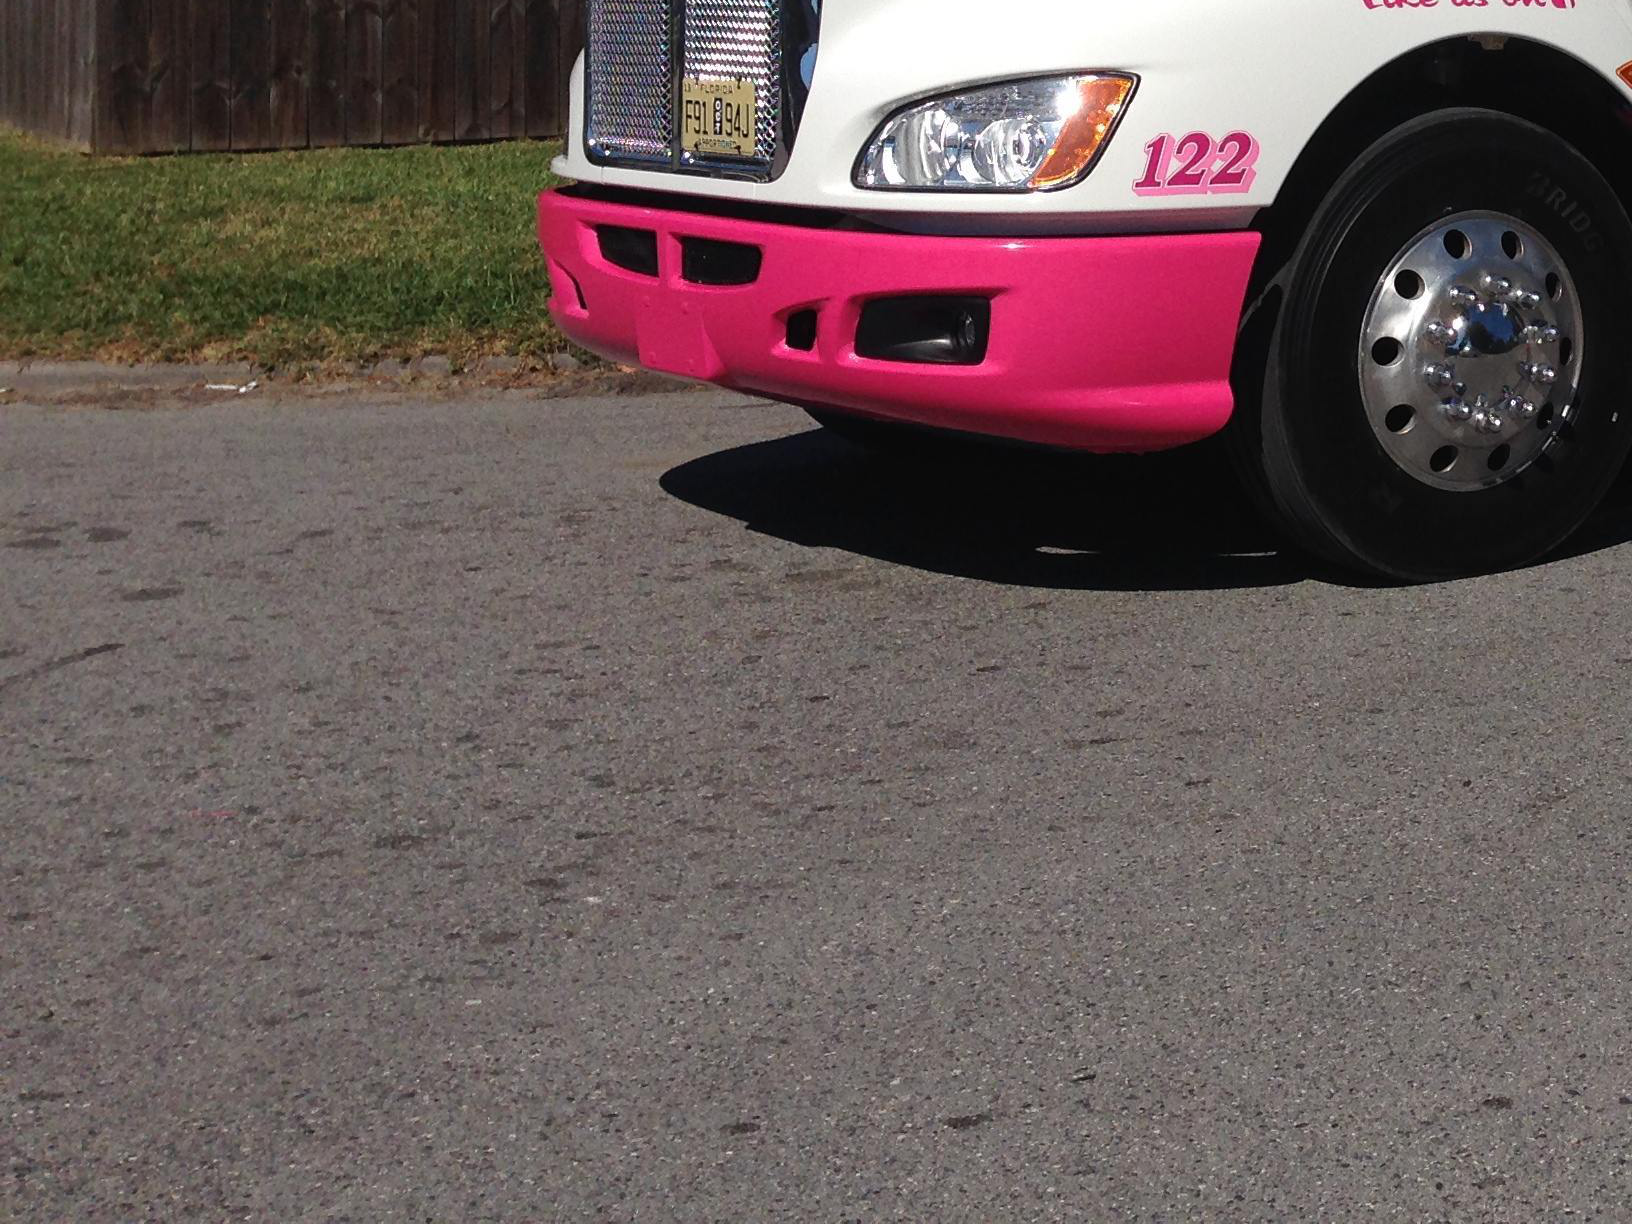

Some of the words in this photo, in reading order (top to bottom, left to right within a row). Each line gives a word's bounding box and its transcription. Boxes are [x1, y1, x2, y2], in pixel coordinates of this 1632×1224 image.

[685, 99, 708, 135] F91
[714, 98, 722, 135] OCT
[725, 102, 750, 138] 94J
[1132, 130, 1260, 196] 122
